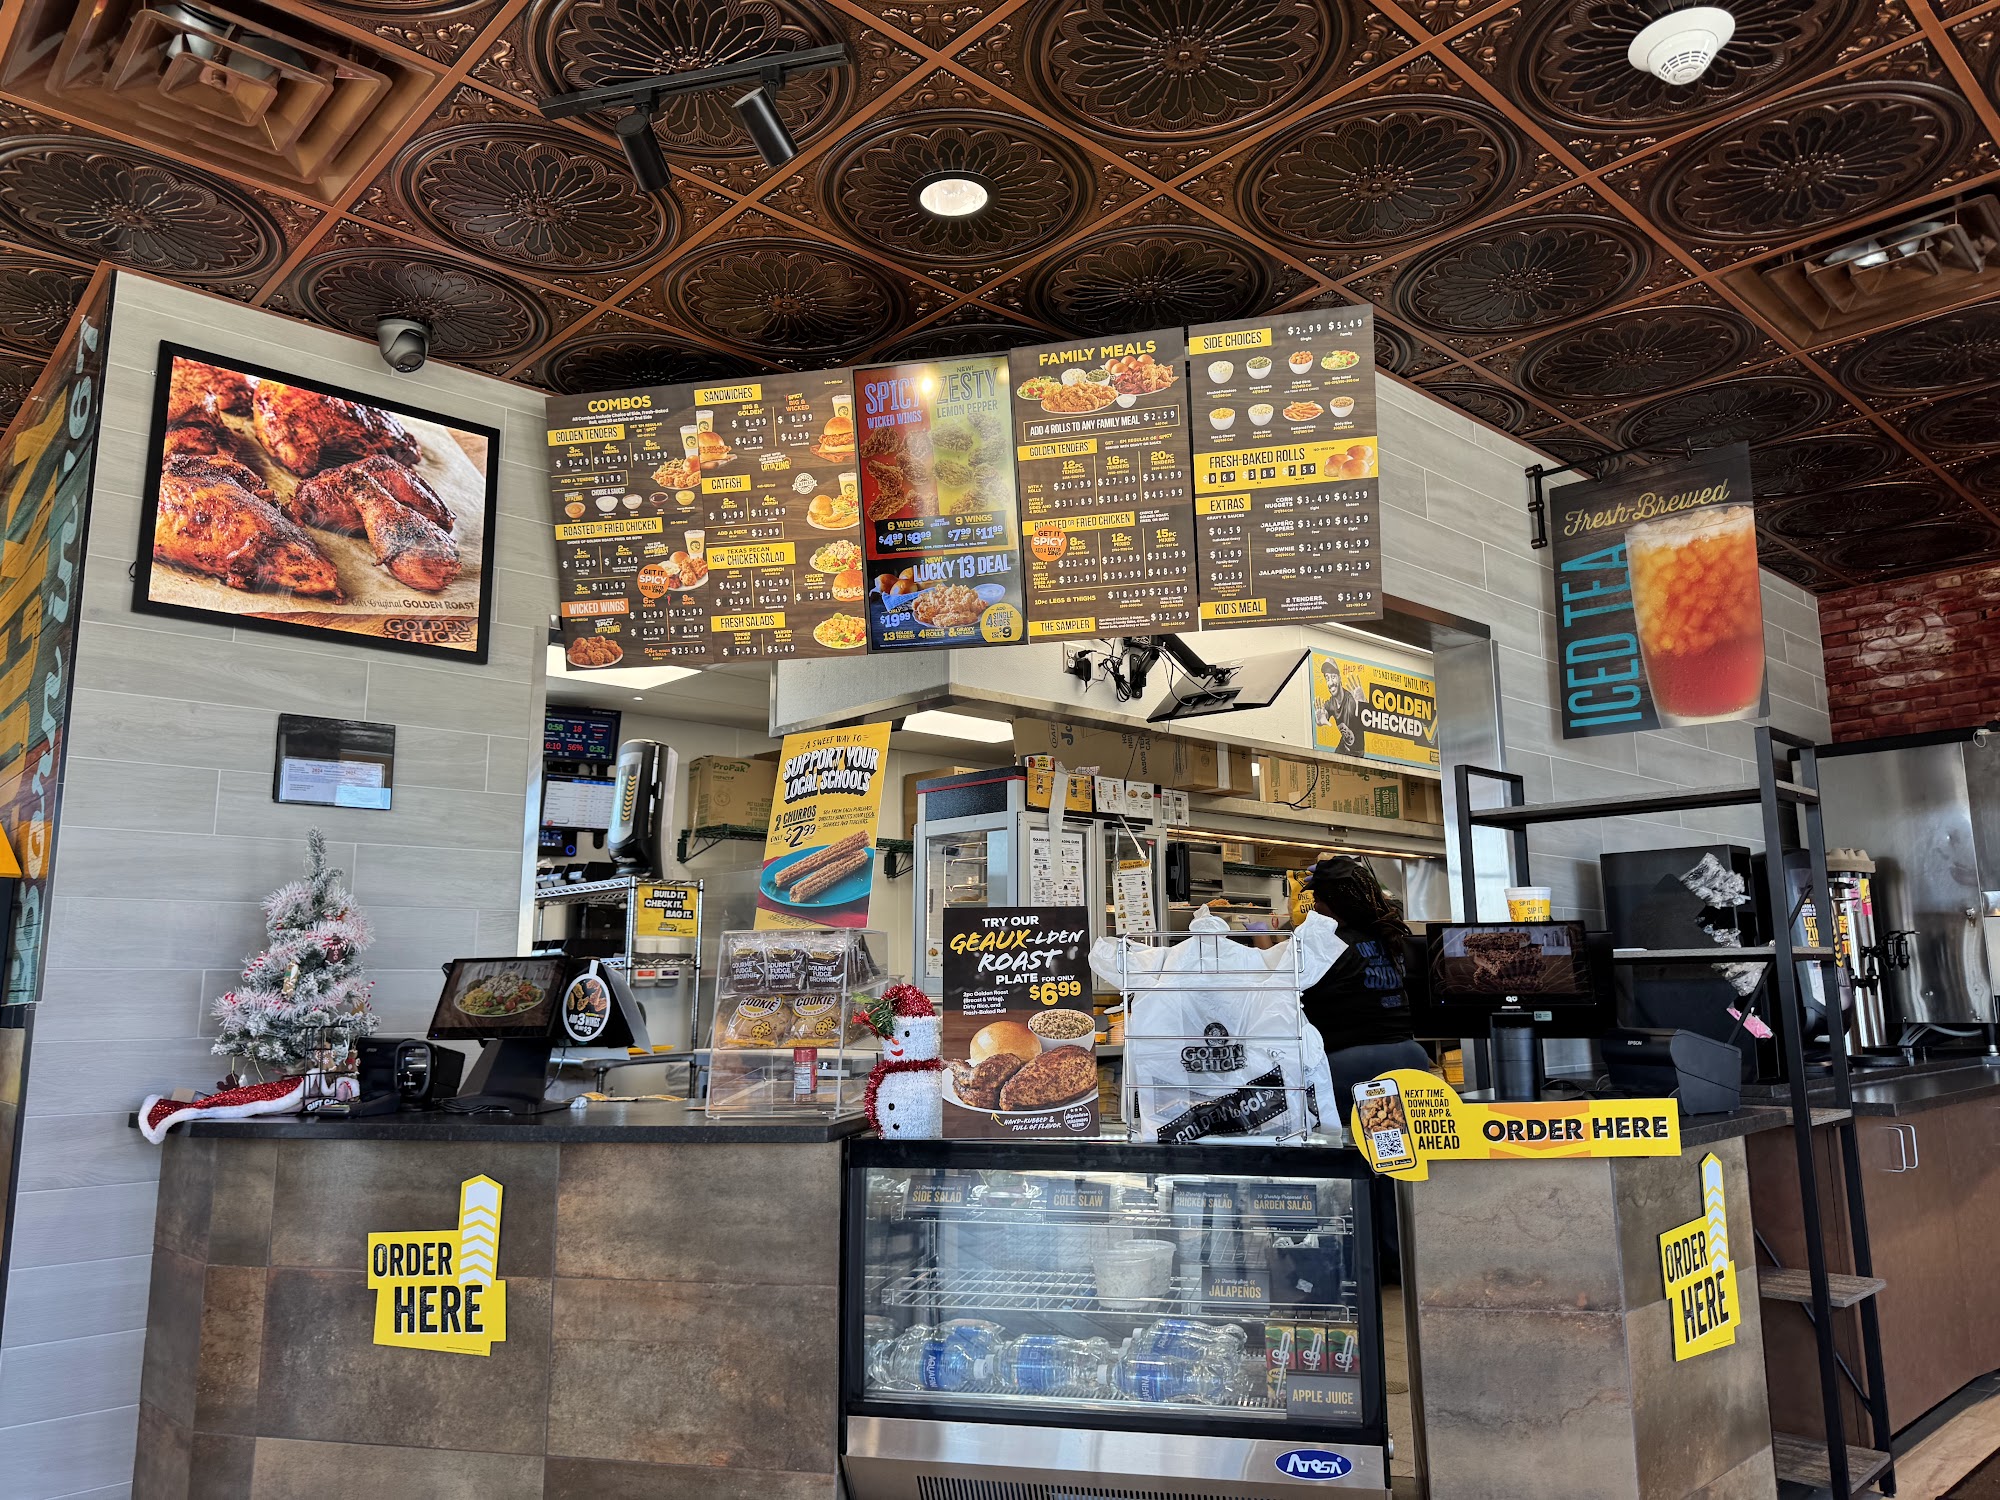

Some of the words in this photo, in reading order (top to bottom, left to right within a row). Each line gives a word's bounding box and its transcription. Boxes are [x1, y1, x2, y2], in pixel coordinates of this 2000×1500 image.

[1204, 335, 1223, 350] SIDE
[1225, 331, 1262, 347] CHOICES
[1039, 348, 1095, 366] FAMILY
[1101, 341, 1157, 359] MEALS
[957, 365, 974, 373] NEW!
[936, 367, 999, 404] ZESTY
[704, 388, 752, 402] SANDWICHES
[865, 377, 920, 414] SPICY
[588, 395, 652, 413] COMBOS
[936, 404, 964, 418] LEMON
[967, 400, 998, 413] PEPPER
[867, 415, 895, 429] WICKED
[897, 411, 922, 424] WINGS
[1030, 426, 1043, 436] ADD
[1044, 426, 1050, 434] 4
[1051, 422, 1070, 434] ROLLS
[1072, 421, 1081, 432] TO
[1082, 419, 1096, 431] ANY
[1096, 417, 1120, 429] FAMILY
[1121, 415, 1140, 426] MEAL
[556, 430, 583, 442] GOLDEN
[585, 427, 617, 440] TENDERS
[1030, 444, 1056, 457] GOLDEN
[1058, 442, 1090, 453] TENDERS
[1209, 450, 1274, 469] FRESH-BAKED
[1276, 448, 1305, 462] ROLLS
[712, 478, 741, 490] CATFISH
[1210, 498, 1244, 511] EXTRAS
[1563, 478, 1731, 537] Fresh-Brewed
[897, 520, 924, 528] WINGS
[965, 514, 992, 523] WINGS
[1076, 517, 1097, 527] FRIED
[1099, 514, 1130, 526] CHICKEN
[564, 524, 595, 536] ROASTED
[605, 523, 624, 534] FRIED
[626, 520, 657, 532] CHICKEN
[1033, 537, 1064, 546] SPICY
[712, 554, 725, 562] NEW
[727, 554, 759, 565] CHICKEN
[761, 552, 785, 563] SALAD
[913, 560, 955, 583] LUCKY
[958, 555, 975, 579] 13
[977, 554, 1011, 576] DEAL
[1259, 567, 1296, 576] JALAPEÑOS
[1561, 542, 1634, 628] TEA
[403, 600, 442, 609] GOLDEN
[444, 601, 474, 609] ROAST
[569, 602, 599, 614] WICKED
[600, 601, 625, 613] WINGS
[1215, 602, 1238, 615] KID'S
[1239, 601, 1263, 614] MEAL
[721, 617, 744, 628] FRESH
[746, 615, 774, 627] SALADS
[993, 610, 1013, 619] SINGLE
[385, 620, 469, 632] GOLDEN
[993, 619, 1010, 627] SIDES
[1041, 621, 1055, 632] THE
[1056, 619, 1090, 631] SAMPLER
[1373, 669, 1381, 678] IT'S
[1382, 671, 1390, 680] NOT
[1391, 672, 1402, 684] RIGHT
[1403, 676, 1419, 690] UNTIL
[1420, 678, 1430, 692] IT'S
[1565, 632, 1642, 728] ICED
[1372, 689, 1432, 721] GOLDEN
[547, 723, 563, 731] 0:58
[1361, 709, 1423, 737] CHECKED
[545, 742, 561, 750] 6:10
[805, 741, 810, 749] A
[812, 737, 834, 747] SWEET
[837, 735, 850, 743] WAY
[853, 734, 862, 742] TO
[713, 763, 745, 772] ProPak
[784, 747, 844, 781] SUPPORT
[846, 746, 879, 771] YOUR
[784, 773, 817, 801] LOCAL
[820, 769, 870, 794] SCHOOLS
[775, 814, 782, 831] 2
[783, 805, 817, 823] CHURROS
[654, 890, 676, 898] BUILD
[1527, 907, 1537, 915] SIP
[982, 917, 1007, 928] TRY
[1010, 916, 1039, 926] OUR
[950, 930, 1084, 954] GEAUX-LDEN
[732, 961, 756, 969] GOURMET
[977, 950, 1063, 973] ROAST
[996, 974, 1038, 985] PLATE
[796, 995, 833, 1007] COOKIE
[1405, 1089, 1424, 1099] NEXT
[1426, 1088, 1444, 1098] TIME
[1407, 1098, 1449, 1108] DOWNLOAD
[1176, 1107, 1228, 1142] GOLDEN
[1228, 1105, 1240, 1118] to
[1240, 1092, 1266, 1116] GO!
[1410, 1108, 1427, 1117] OUR
[1428, 1108, 1443, 1117] APP
[1445, 1108, 1452, 1117] &
[1004, 1117, 1048, 1125] HAND-RUBBED
[1414, 1119, 1456, 1134] ORDER
[1483, 1119, 1584, 1142] ORDER
[1593, 1116, 1668, 1139] HERE
[1418, 1135, 1460, 1150] AHEAD
[913, 1191, 932, 1202] SIDE
[934, 1192, 962, 1203] SALAD
[1054, 1195, 1076, 1206] COLE
[1078, 1196, 1104, 1207] SLAW
[1175, 1197, 1207, 1208] CHICKEN
[1209, 1199, 1233, 1209] SALAD
[1254, 1200, 1285, 1210] GARDEN
[1287, 1201, 1312, 1211] SALAD
[373, 1242, 452, 1277] ORDER
[1665, 1230, 1709, 1284] ORDER
[1209, 1285, 1262, 1299] JALAPEÑOS
[394, 1284, 484, 1334] HERE
[1681, 1270, 1729, 1344] HERE
[1292, 1389, 1323, 1403] APPLE
[1326, 1393, 1353, 1405] JUICE
